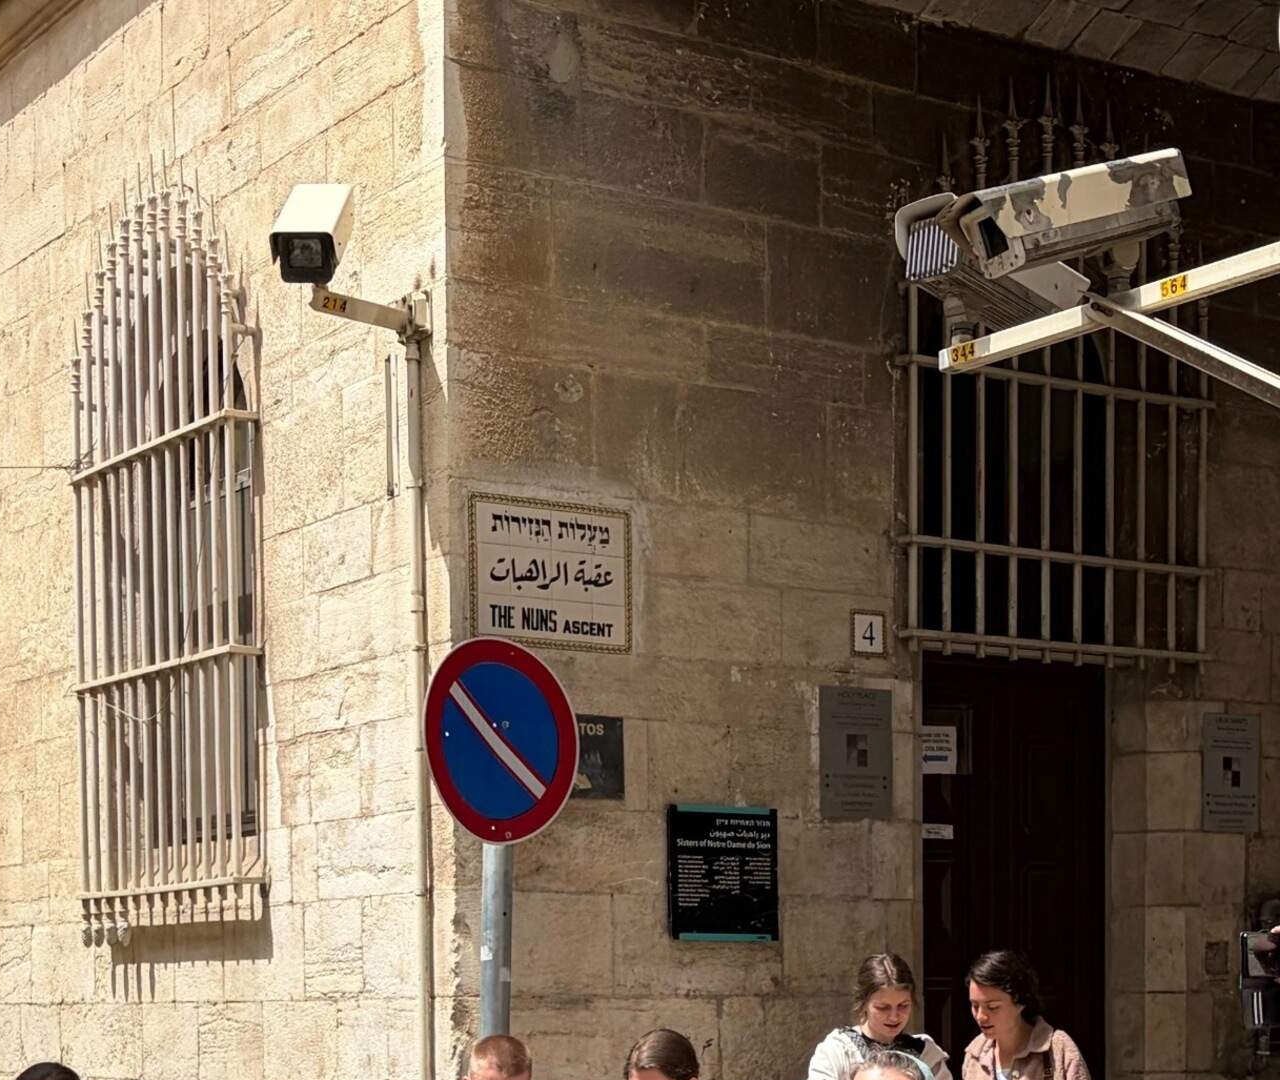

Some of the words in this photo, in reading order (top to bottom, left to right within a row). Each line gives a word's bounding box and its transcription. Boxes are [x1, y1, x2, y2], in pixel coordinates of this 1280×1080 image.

[1161, 274, 1187, 297] 564
[323, 296, 347, 312] 214
[952, 342, 975, 362] 344
[490, 557, 568, 590] الراهبات
[574, 560, 613, 592] عقبة
[490, 604, 515, 629] THE
[522, 607, 557, 632] NUNS
[563, 619, 613, 638] ASCENT
[862, 621, 876, 647] 4
[578, 722, 605, 736] TOS
[677, 838, 699, 847] Sisters
[700, 839, 707, 847] of
[708, 839, 726, 848] Notre
[756, 841, 771, 849] Sion
